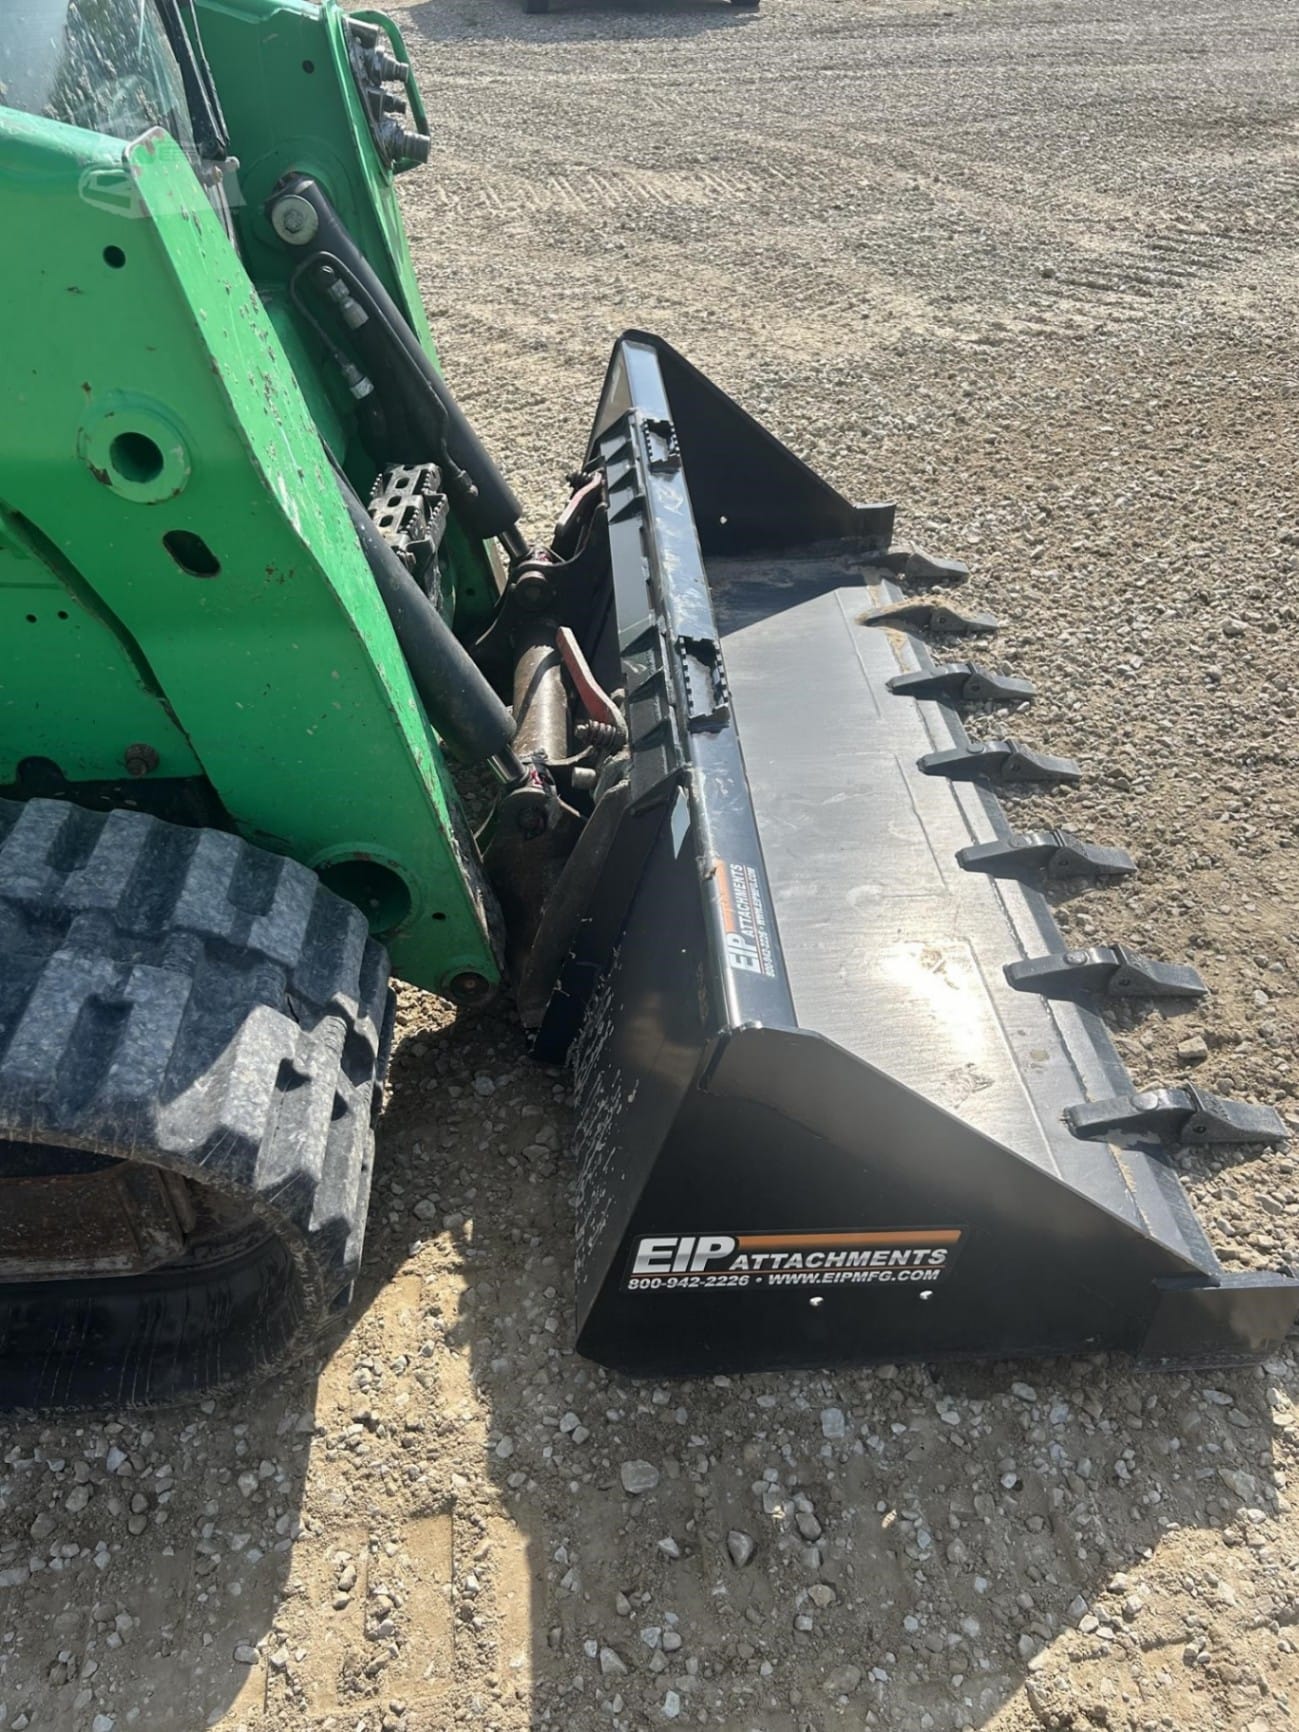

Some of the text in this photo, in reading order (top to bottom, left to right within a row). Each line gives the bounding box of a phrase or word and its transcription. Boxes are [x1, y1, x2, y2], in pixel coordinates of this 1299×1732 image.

[726, 864, 762, 974] EIP ATTACHMENTS
[632, 1236, 948, 1274] EIP ATTACHMENTS
[627, 1269, 941, 1291] 800-942-2226 WWW.EIPMFG.COM
